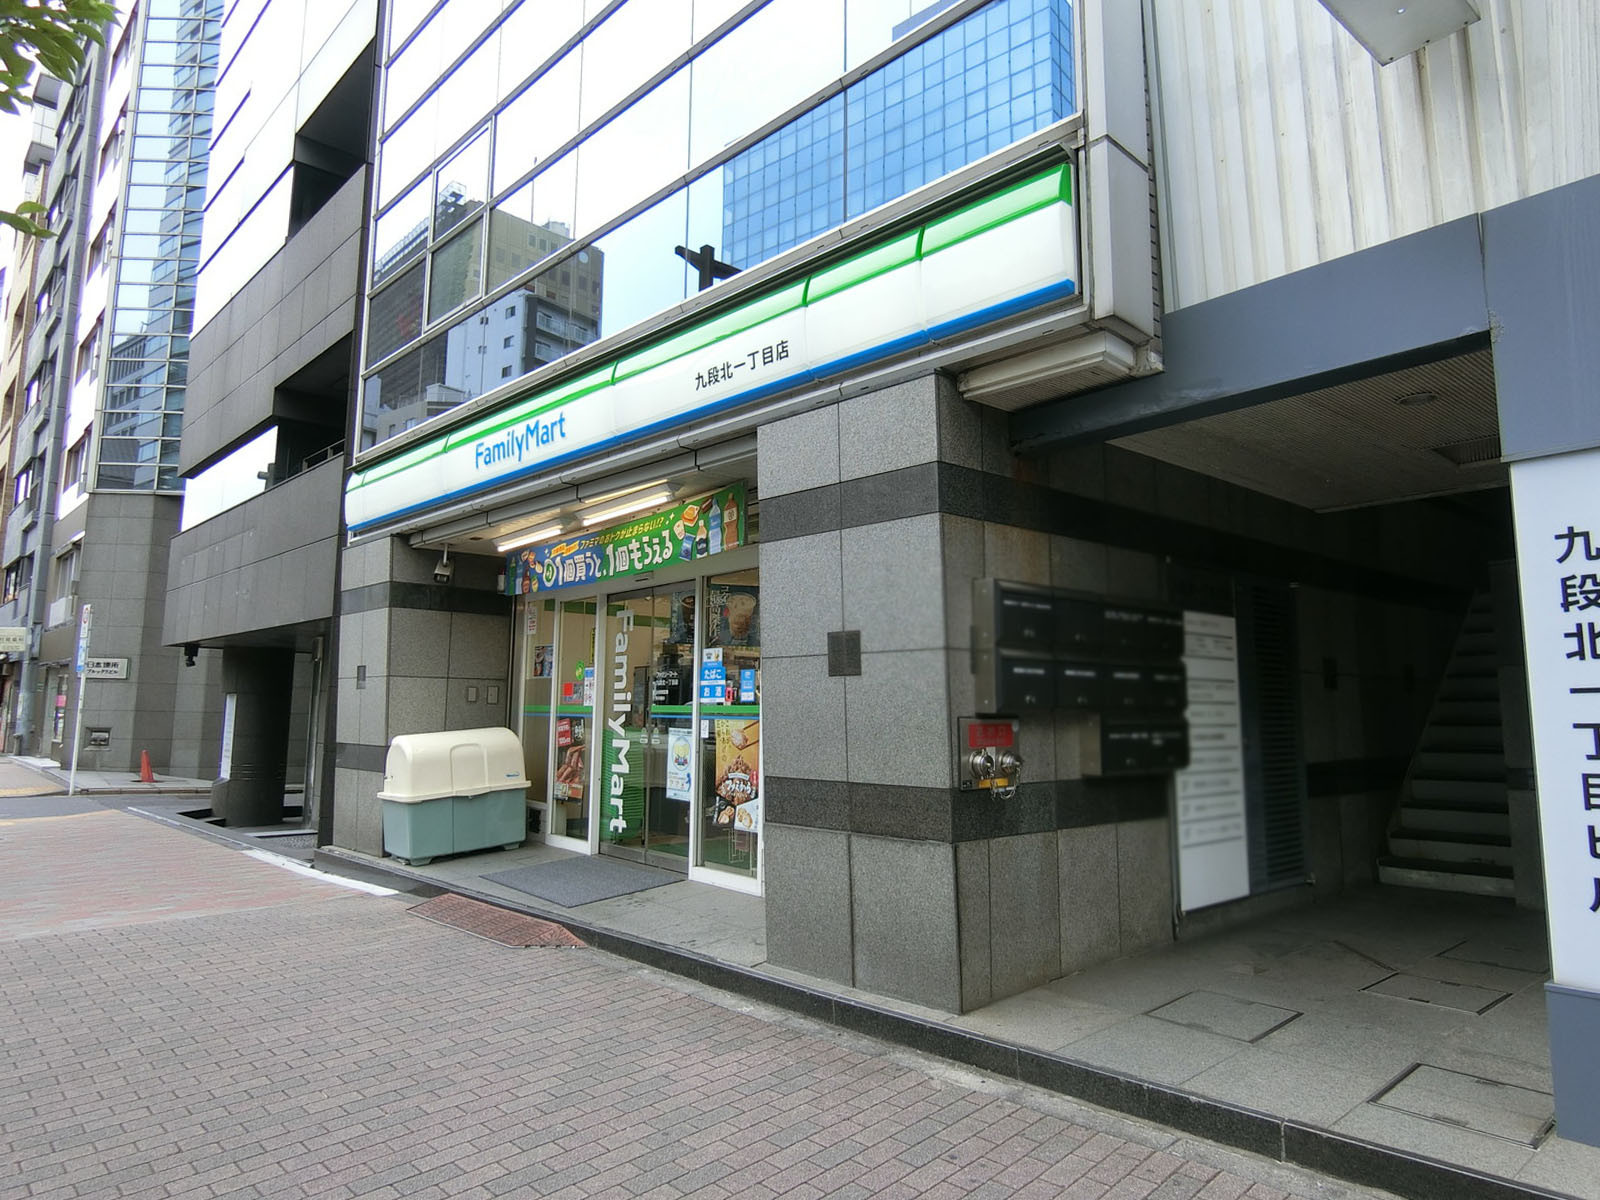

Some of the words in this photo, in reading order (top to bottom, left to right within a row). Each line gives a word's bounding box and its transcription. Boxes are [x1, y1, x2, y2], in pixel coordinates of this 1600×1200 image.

[695, 340, 789, 391] 九段北一丁目店
[475, 412, 565, 469] FamilyMart
[703, 669, 722, 679] たばこ
[608, 610, 635, 834] FamilyMart
